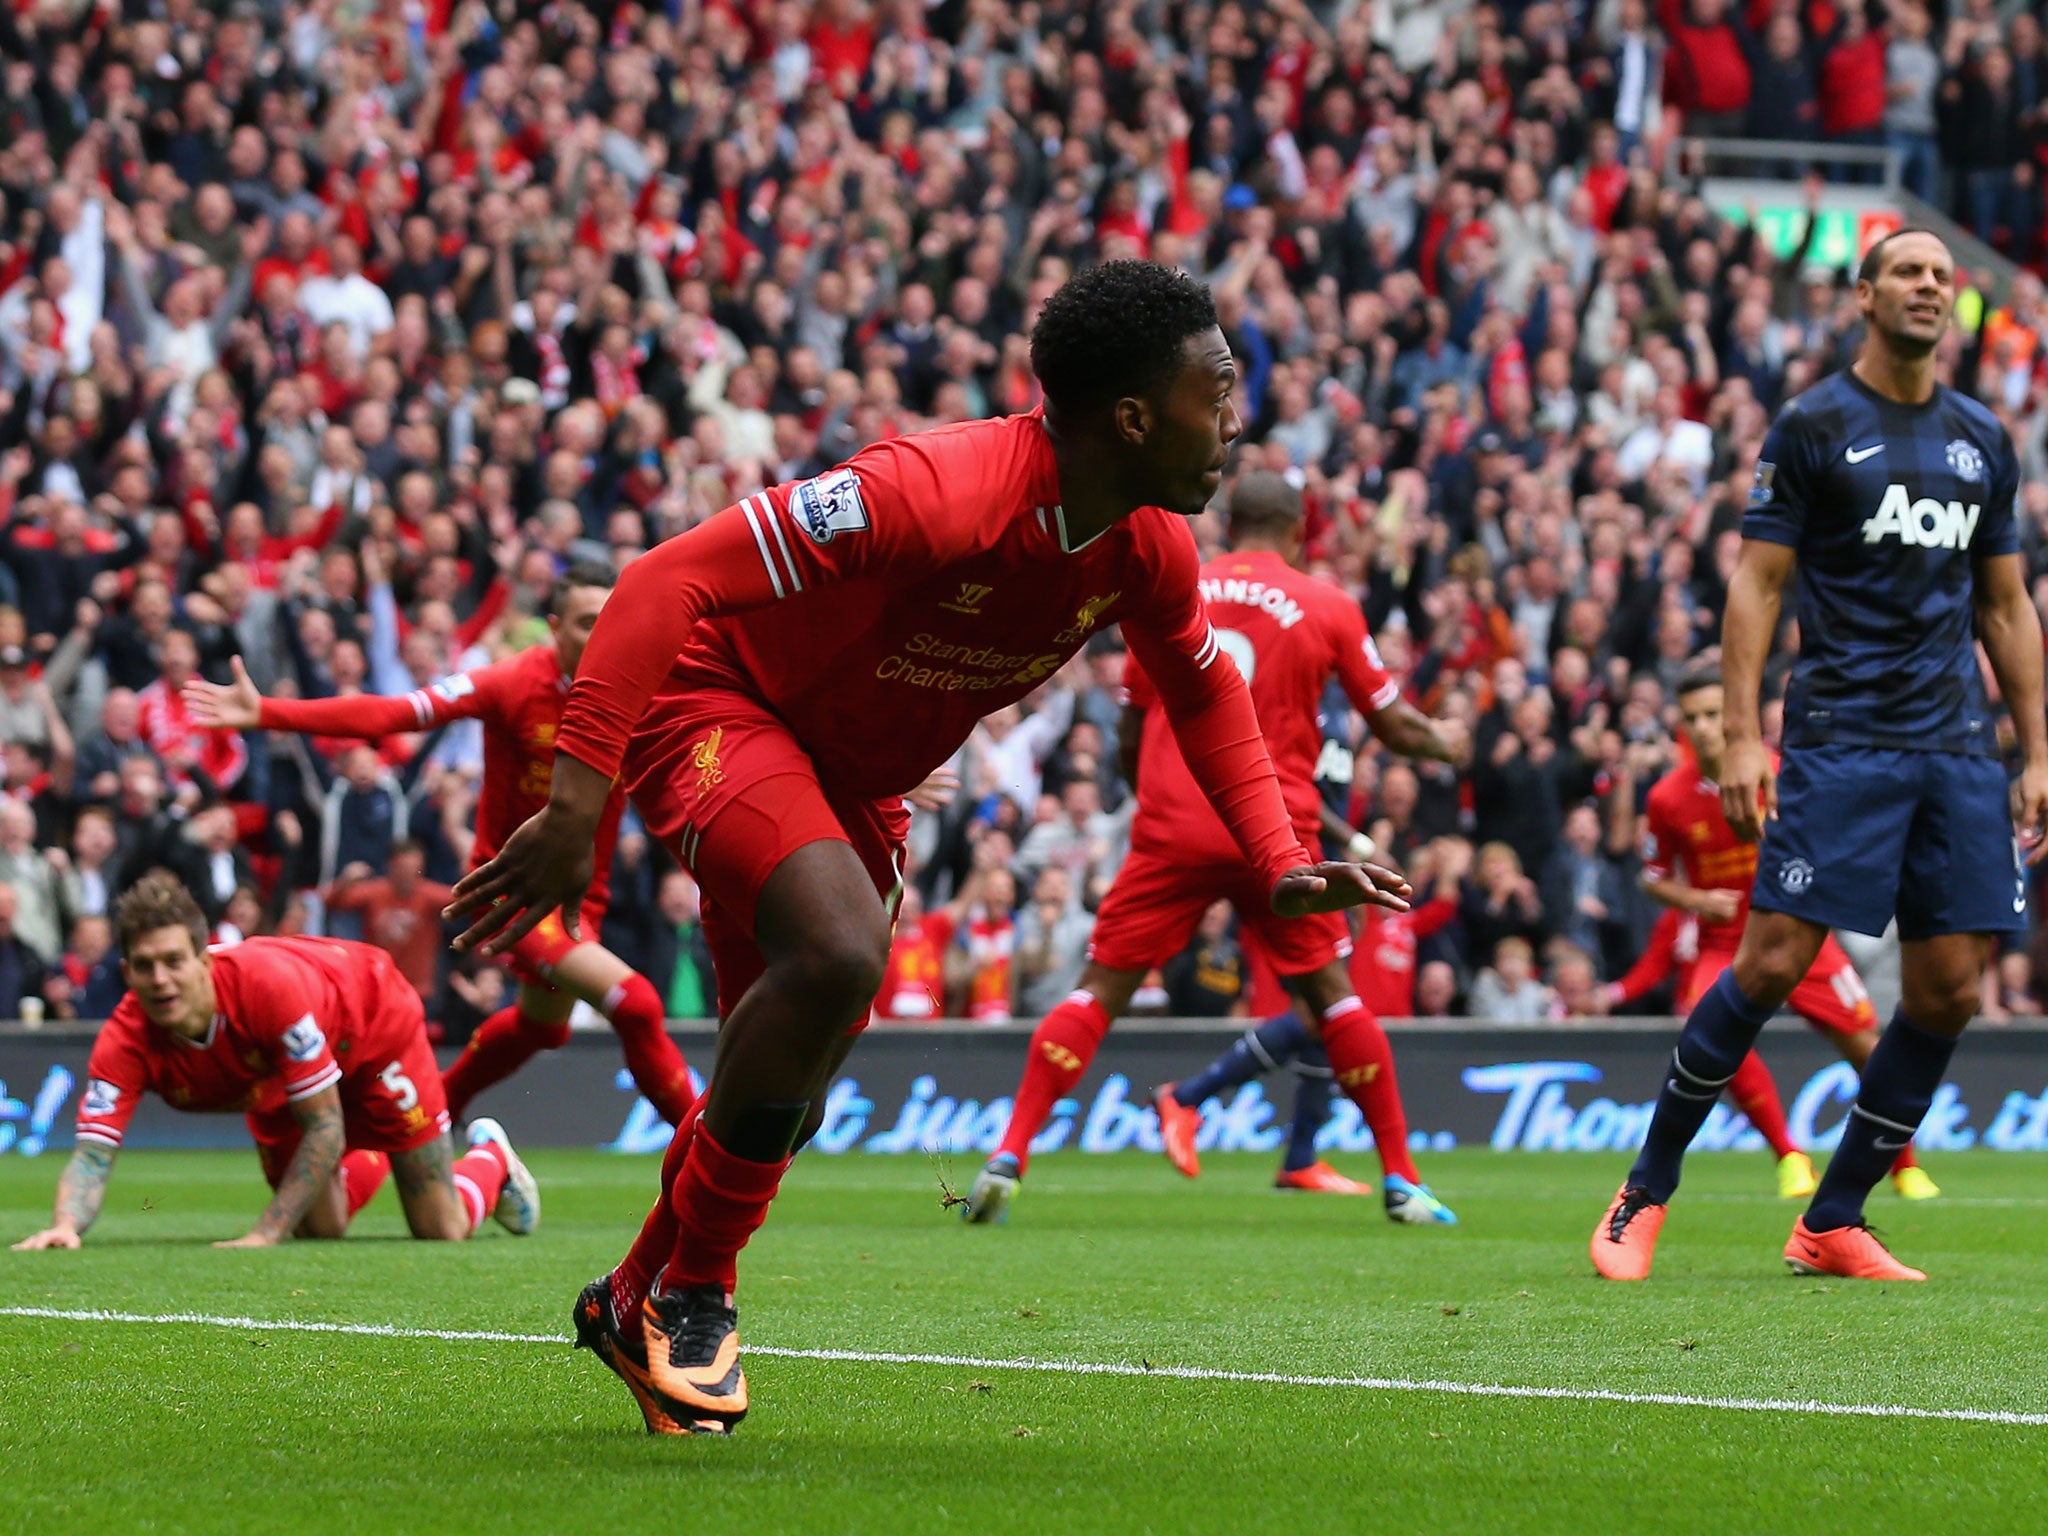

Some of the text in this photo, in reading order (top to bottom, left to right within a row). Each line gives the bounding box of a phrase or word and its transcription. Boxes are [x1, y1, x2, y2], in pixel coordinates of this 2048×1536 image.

[803, 484, 823, 525] BARCLAYS
[904, 633, 1035, 670] Standard
[875, 655, 1007, 691] Chartered
[381, 1060, 418, 1112] 5
